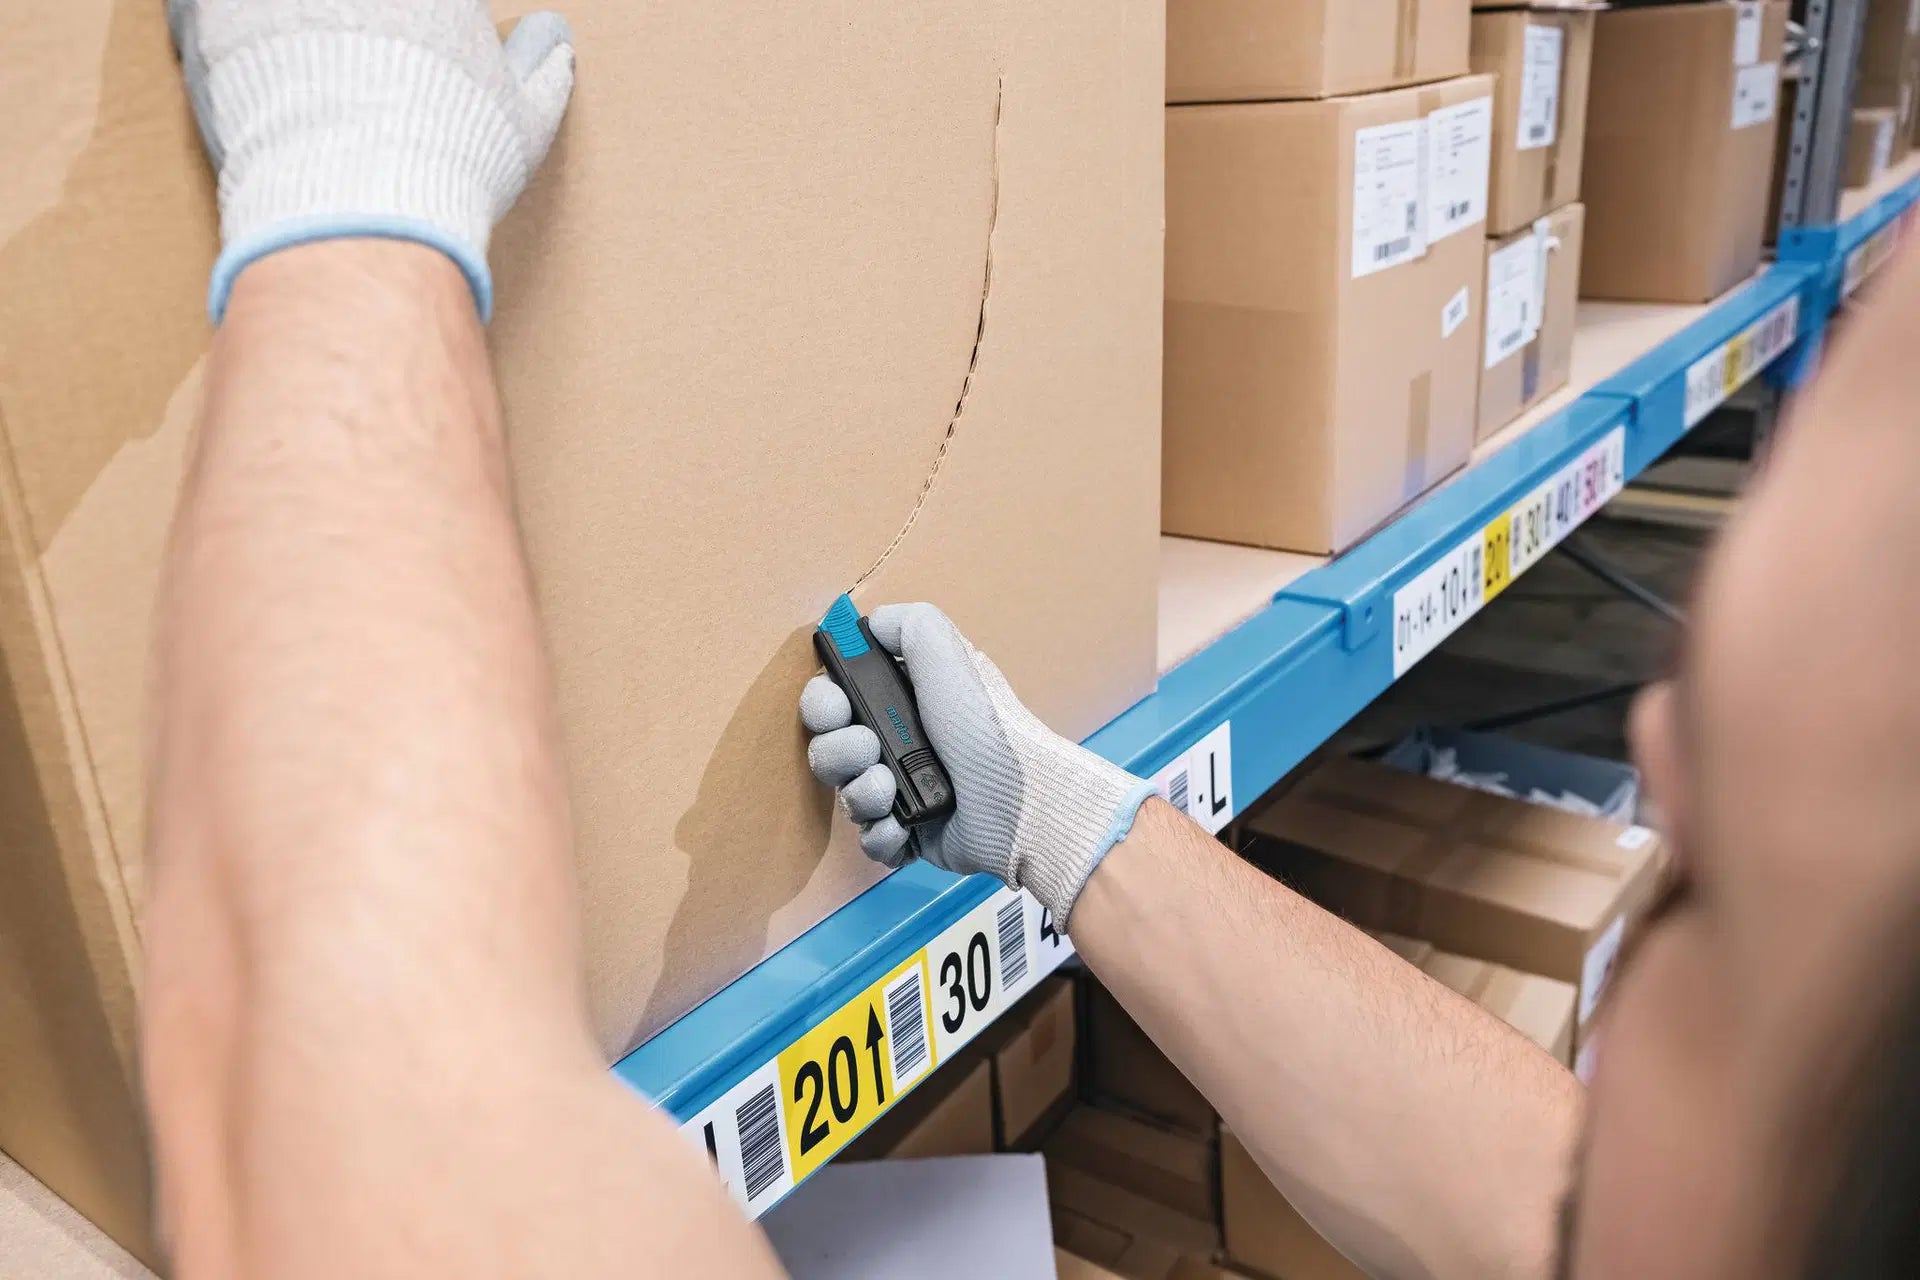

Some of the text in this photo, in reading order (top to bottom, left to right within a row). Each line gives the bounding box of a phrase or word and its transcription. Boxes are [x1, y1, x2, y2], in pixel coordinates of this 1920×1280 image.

[886, 704, 913, 745] martor
[793, 1035, 859, 1157] 20
[939, 931, 991, 1034] 30
[1040, 906, 1060, 949] 4
